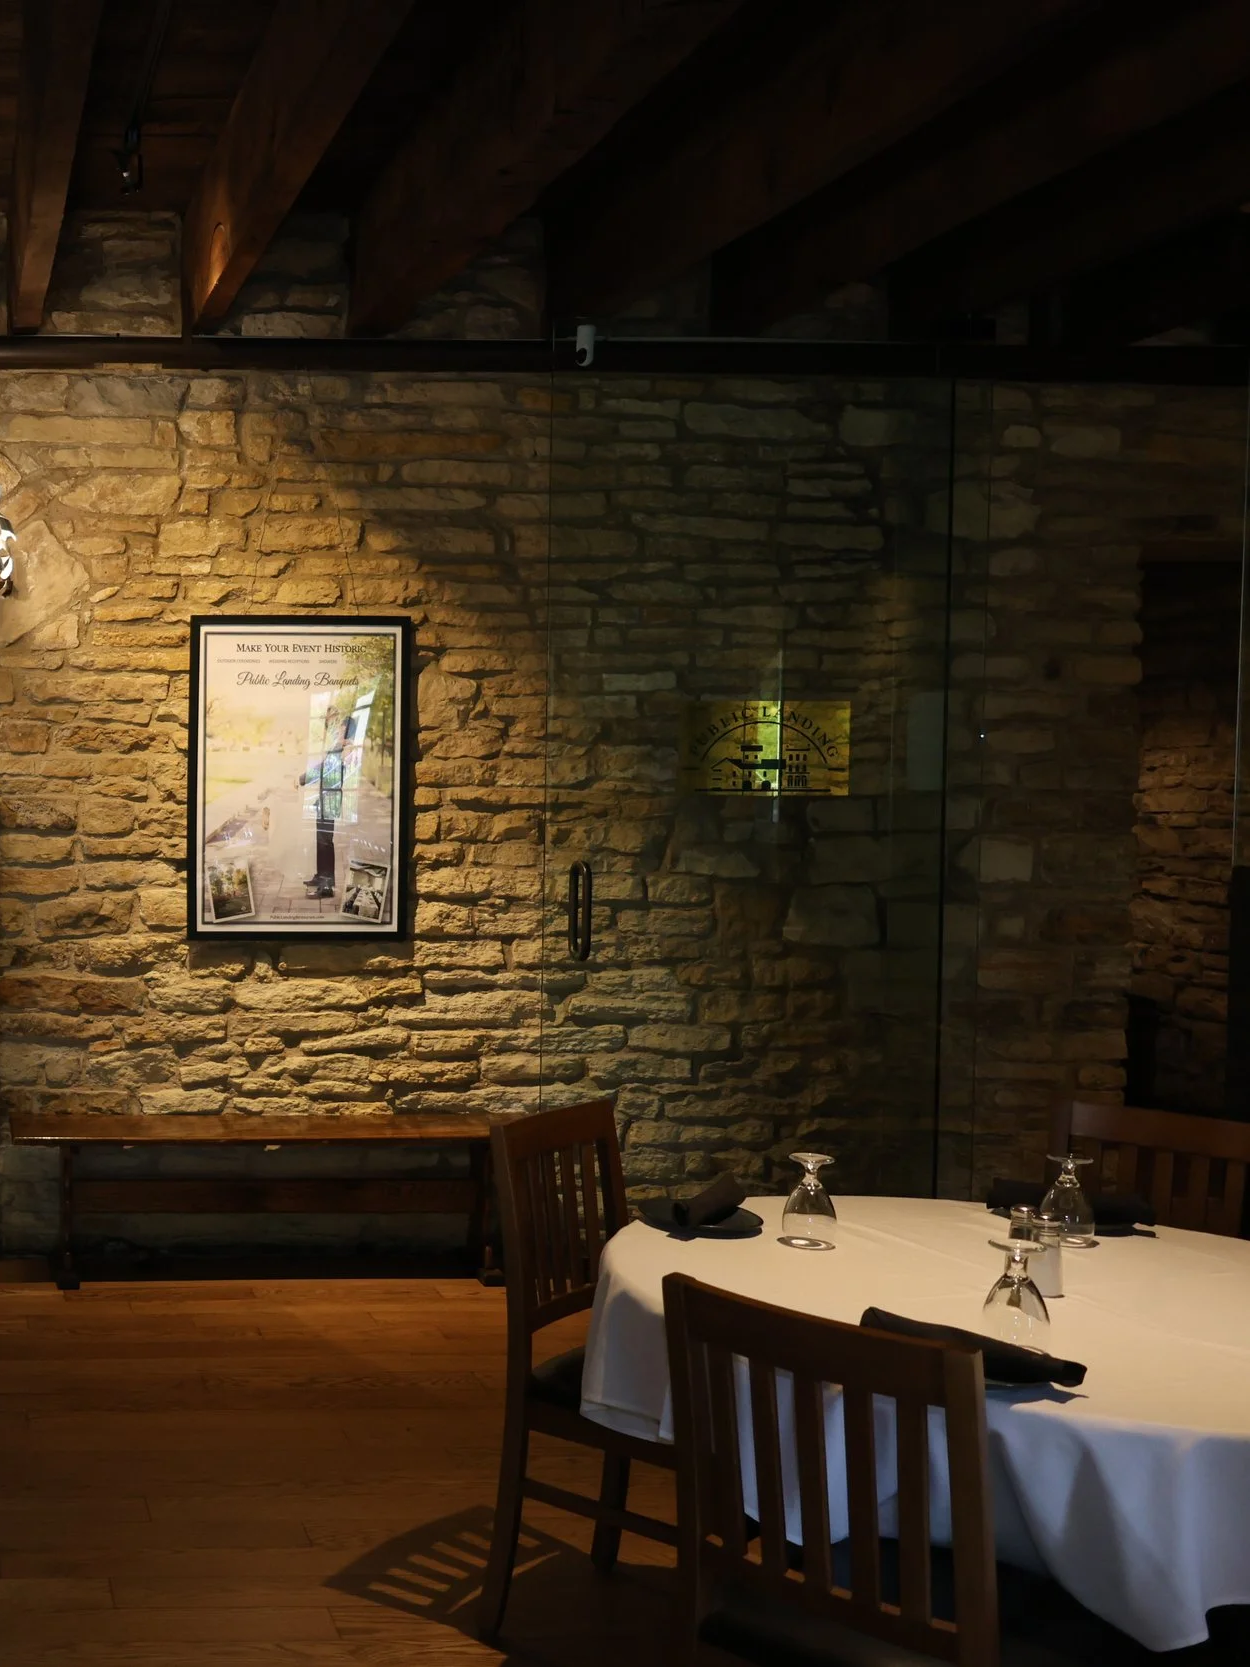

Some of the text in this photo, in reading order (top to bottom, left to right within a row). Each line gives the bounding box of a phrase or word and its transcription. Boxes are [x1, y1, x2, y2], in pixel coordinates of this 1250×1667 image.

[236, 643, 367, 653] MAKE YOUR EVENT HISTORIC
[236, 670, 359, 690] Public Landing Banquets
[690, 706, 753, 757] PUBLIC
